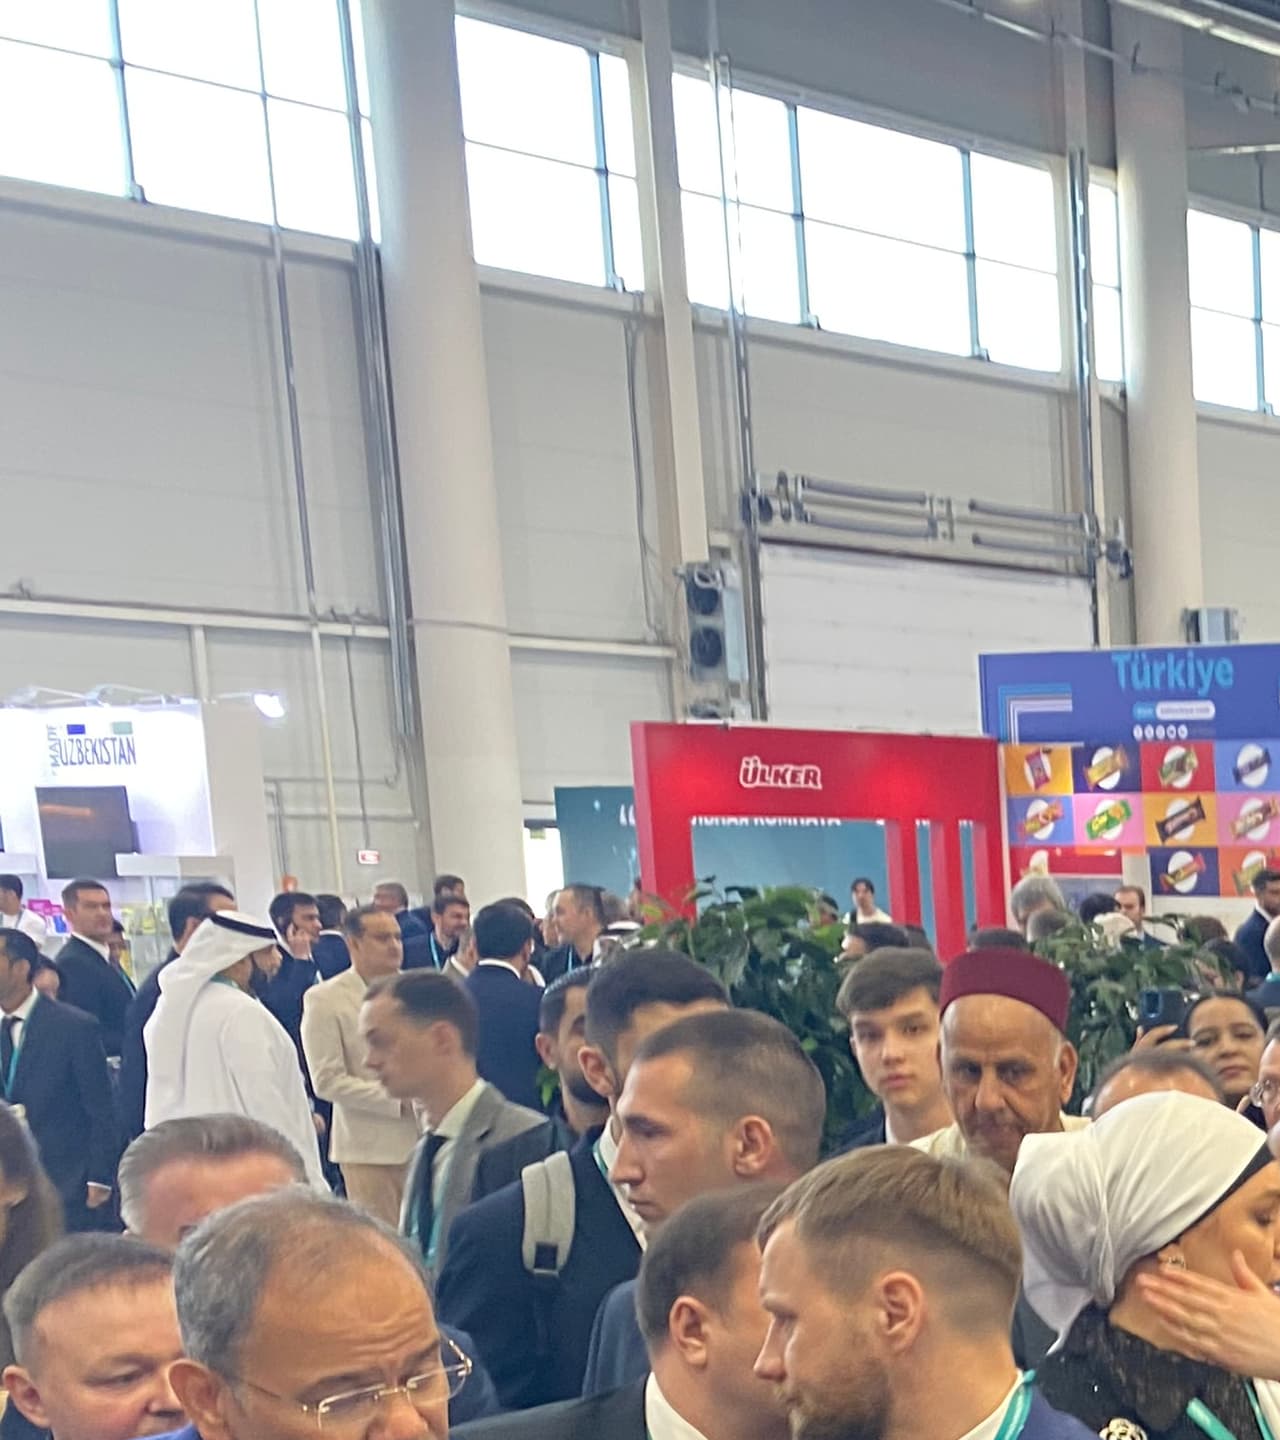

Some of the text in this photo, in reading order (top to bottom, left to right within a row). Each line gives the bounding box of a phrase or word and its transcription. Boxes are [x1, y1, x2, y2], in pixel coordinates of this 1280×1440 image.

[1111, 649, 1234, 698] Türkiye
[57, 736, 137, 767] UZBEKISTAN
[739, 755, 823, 790] ÜLKER
